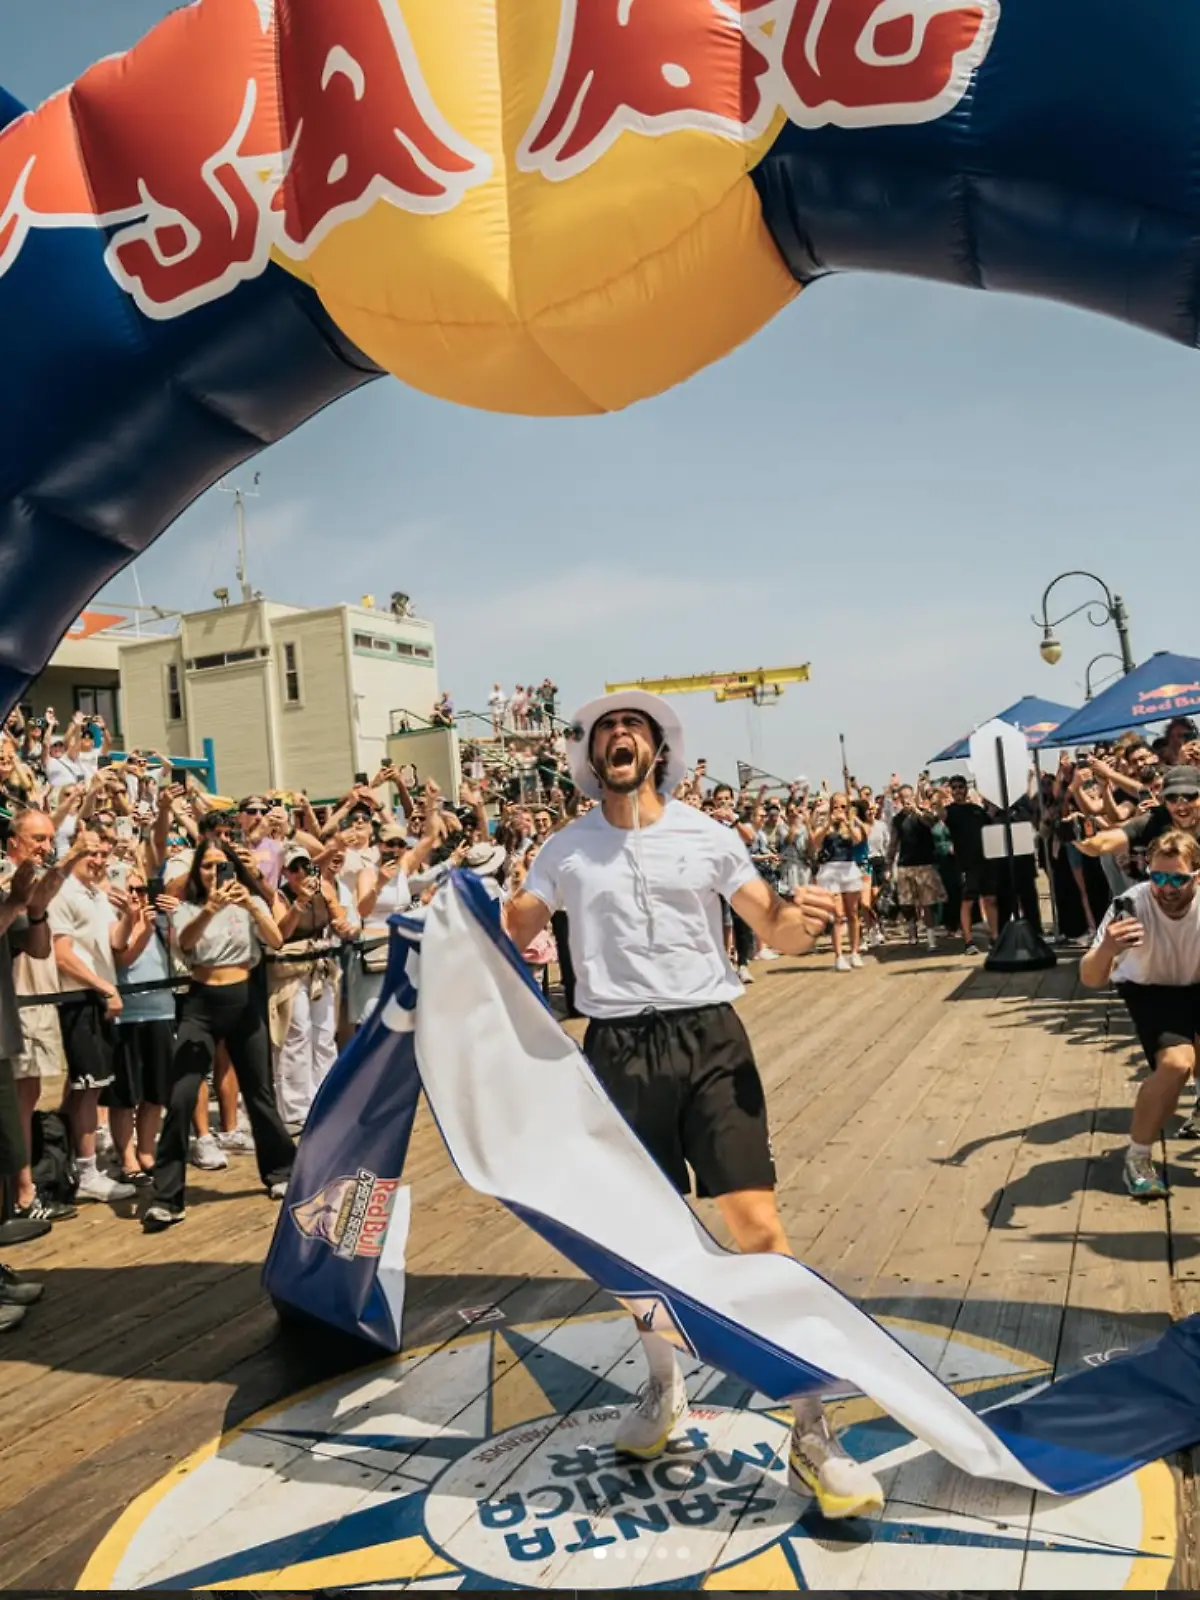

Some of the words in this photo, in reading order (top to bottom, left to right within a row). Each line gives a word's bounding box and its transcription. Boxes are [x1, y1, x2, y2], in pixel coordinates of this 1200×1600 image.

[1132, 699, 1171, 716] Red
[367, 1179, 399, 1217] Red
[356, 1220, 388, 1256] Bull
[588, 1409, 621, 1423] DAY
[547, 1427, 709, 1477] PER
[477, 1441, 786, 1529] MONICA
[504, 1480, 777, 1562] SANTA
